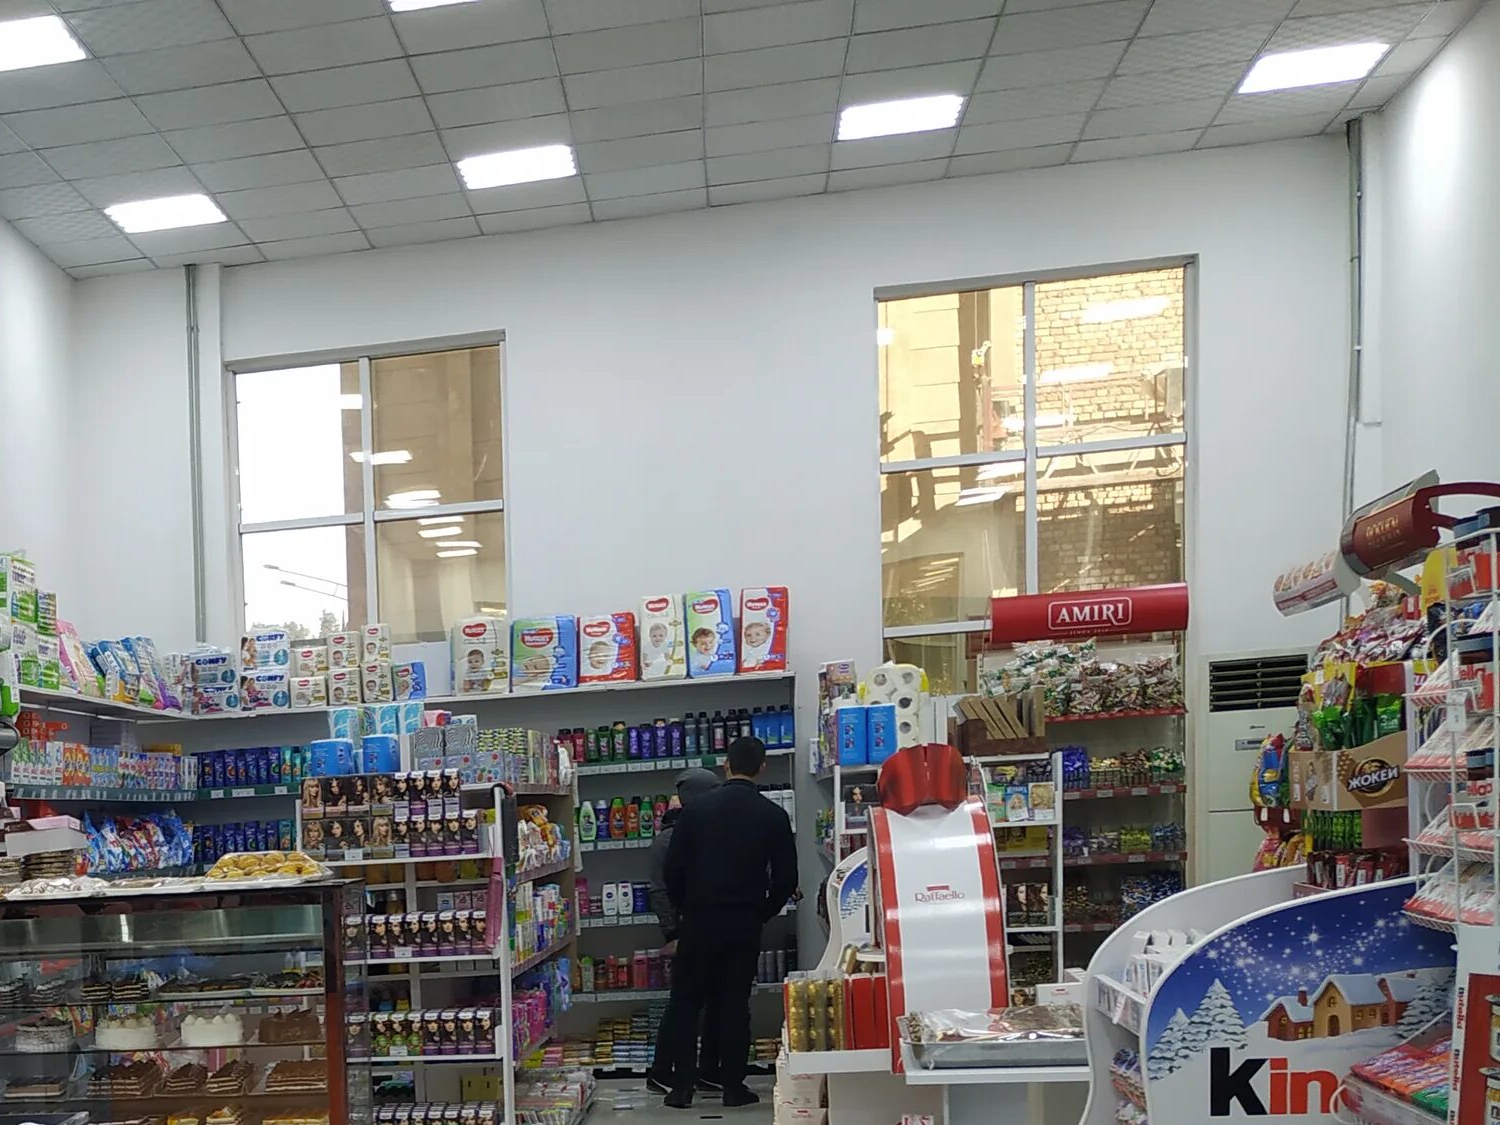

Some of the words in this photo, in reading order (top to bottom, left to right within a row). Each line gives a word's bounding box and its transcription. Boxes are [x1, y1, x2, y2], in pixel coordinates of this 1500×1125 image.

[1056, 603, 1124, 625] AMIRI
[914, 890, 965, 903] Raffaello
[1210, 1047, 1338, 1117] kin
